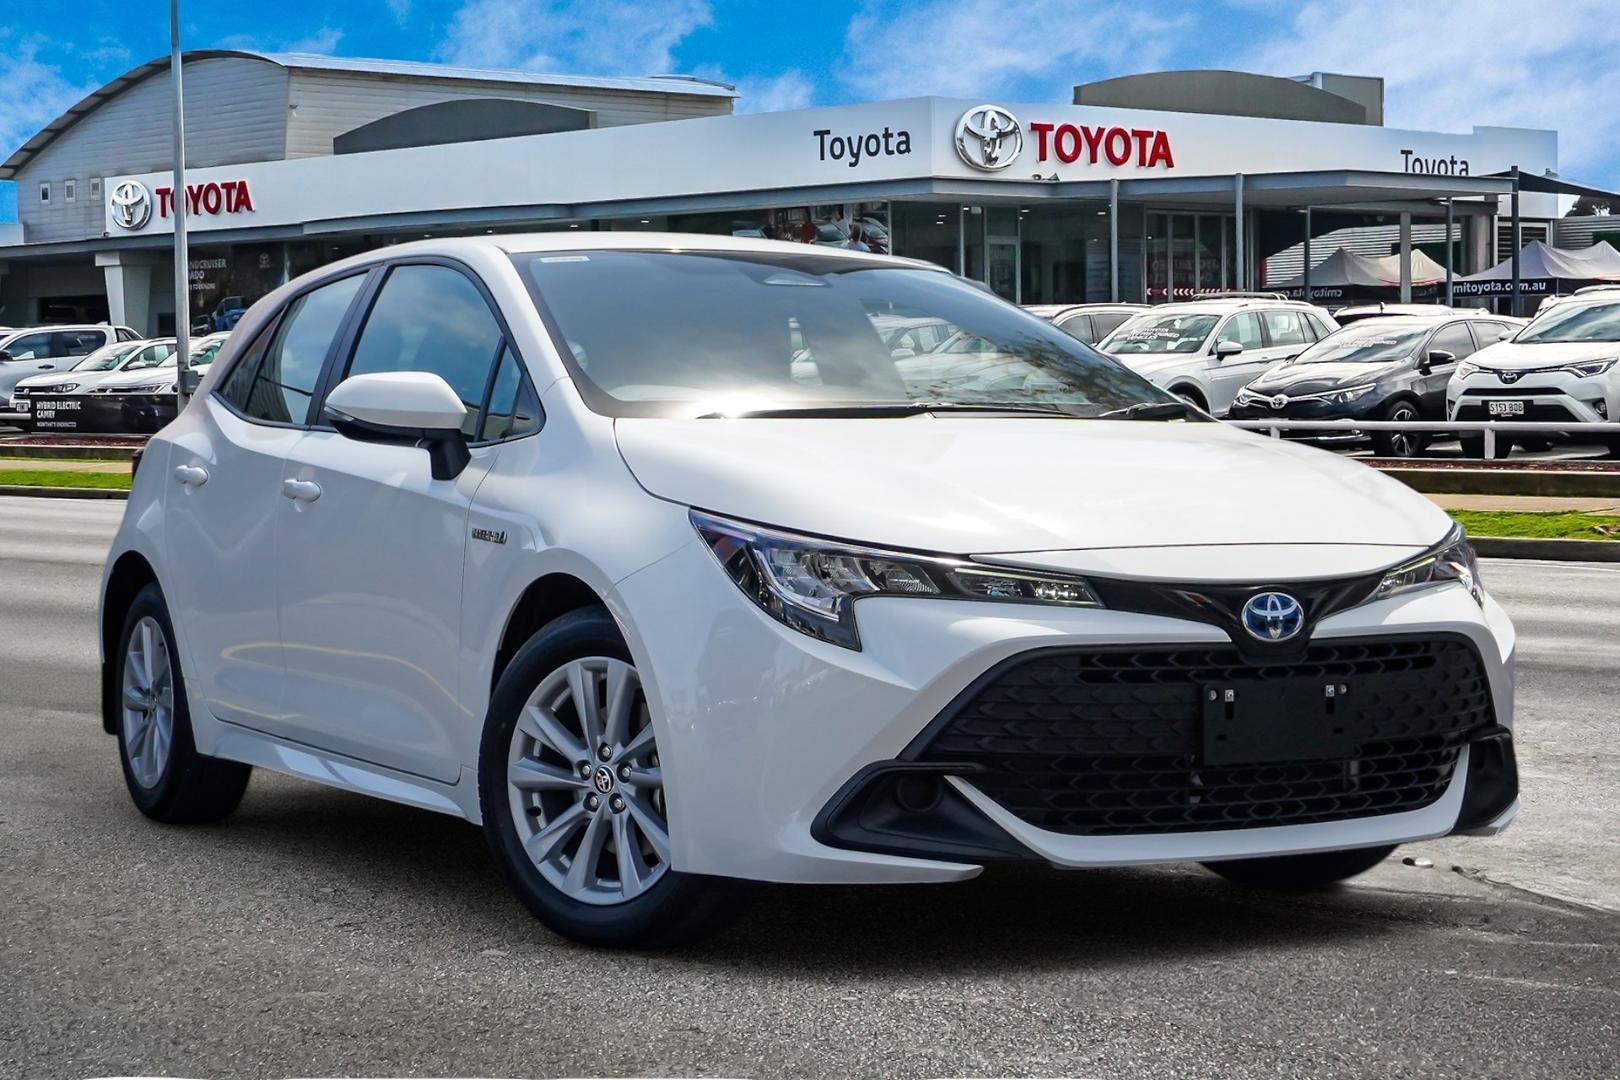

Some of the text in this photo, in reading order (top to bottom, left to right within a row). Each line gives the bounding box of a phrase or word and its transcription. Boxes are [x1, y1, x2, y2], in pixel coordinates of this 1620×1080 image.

[813, 127, 911, 167] Toyota
[1030, 122, 1174, 168] TOYOTA
[1453, 281, 1547, 295] mitoyota.cm.au
